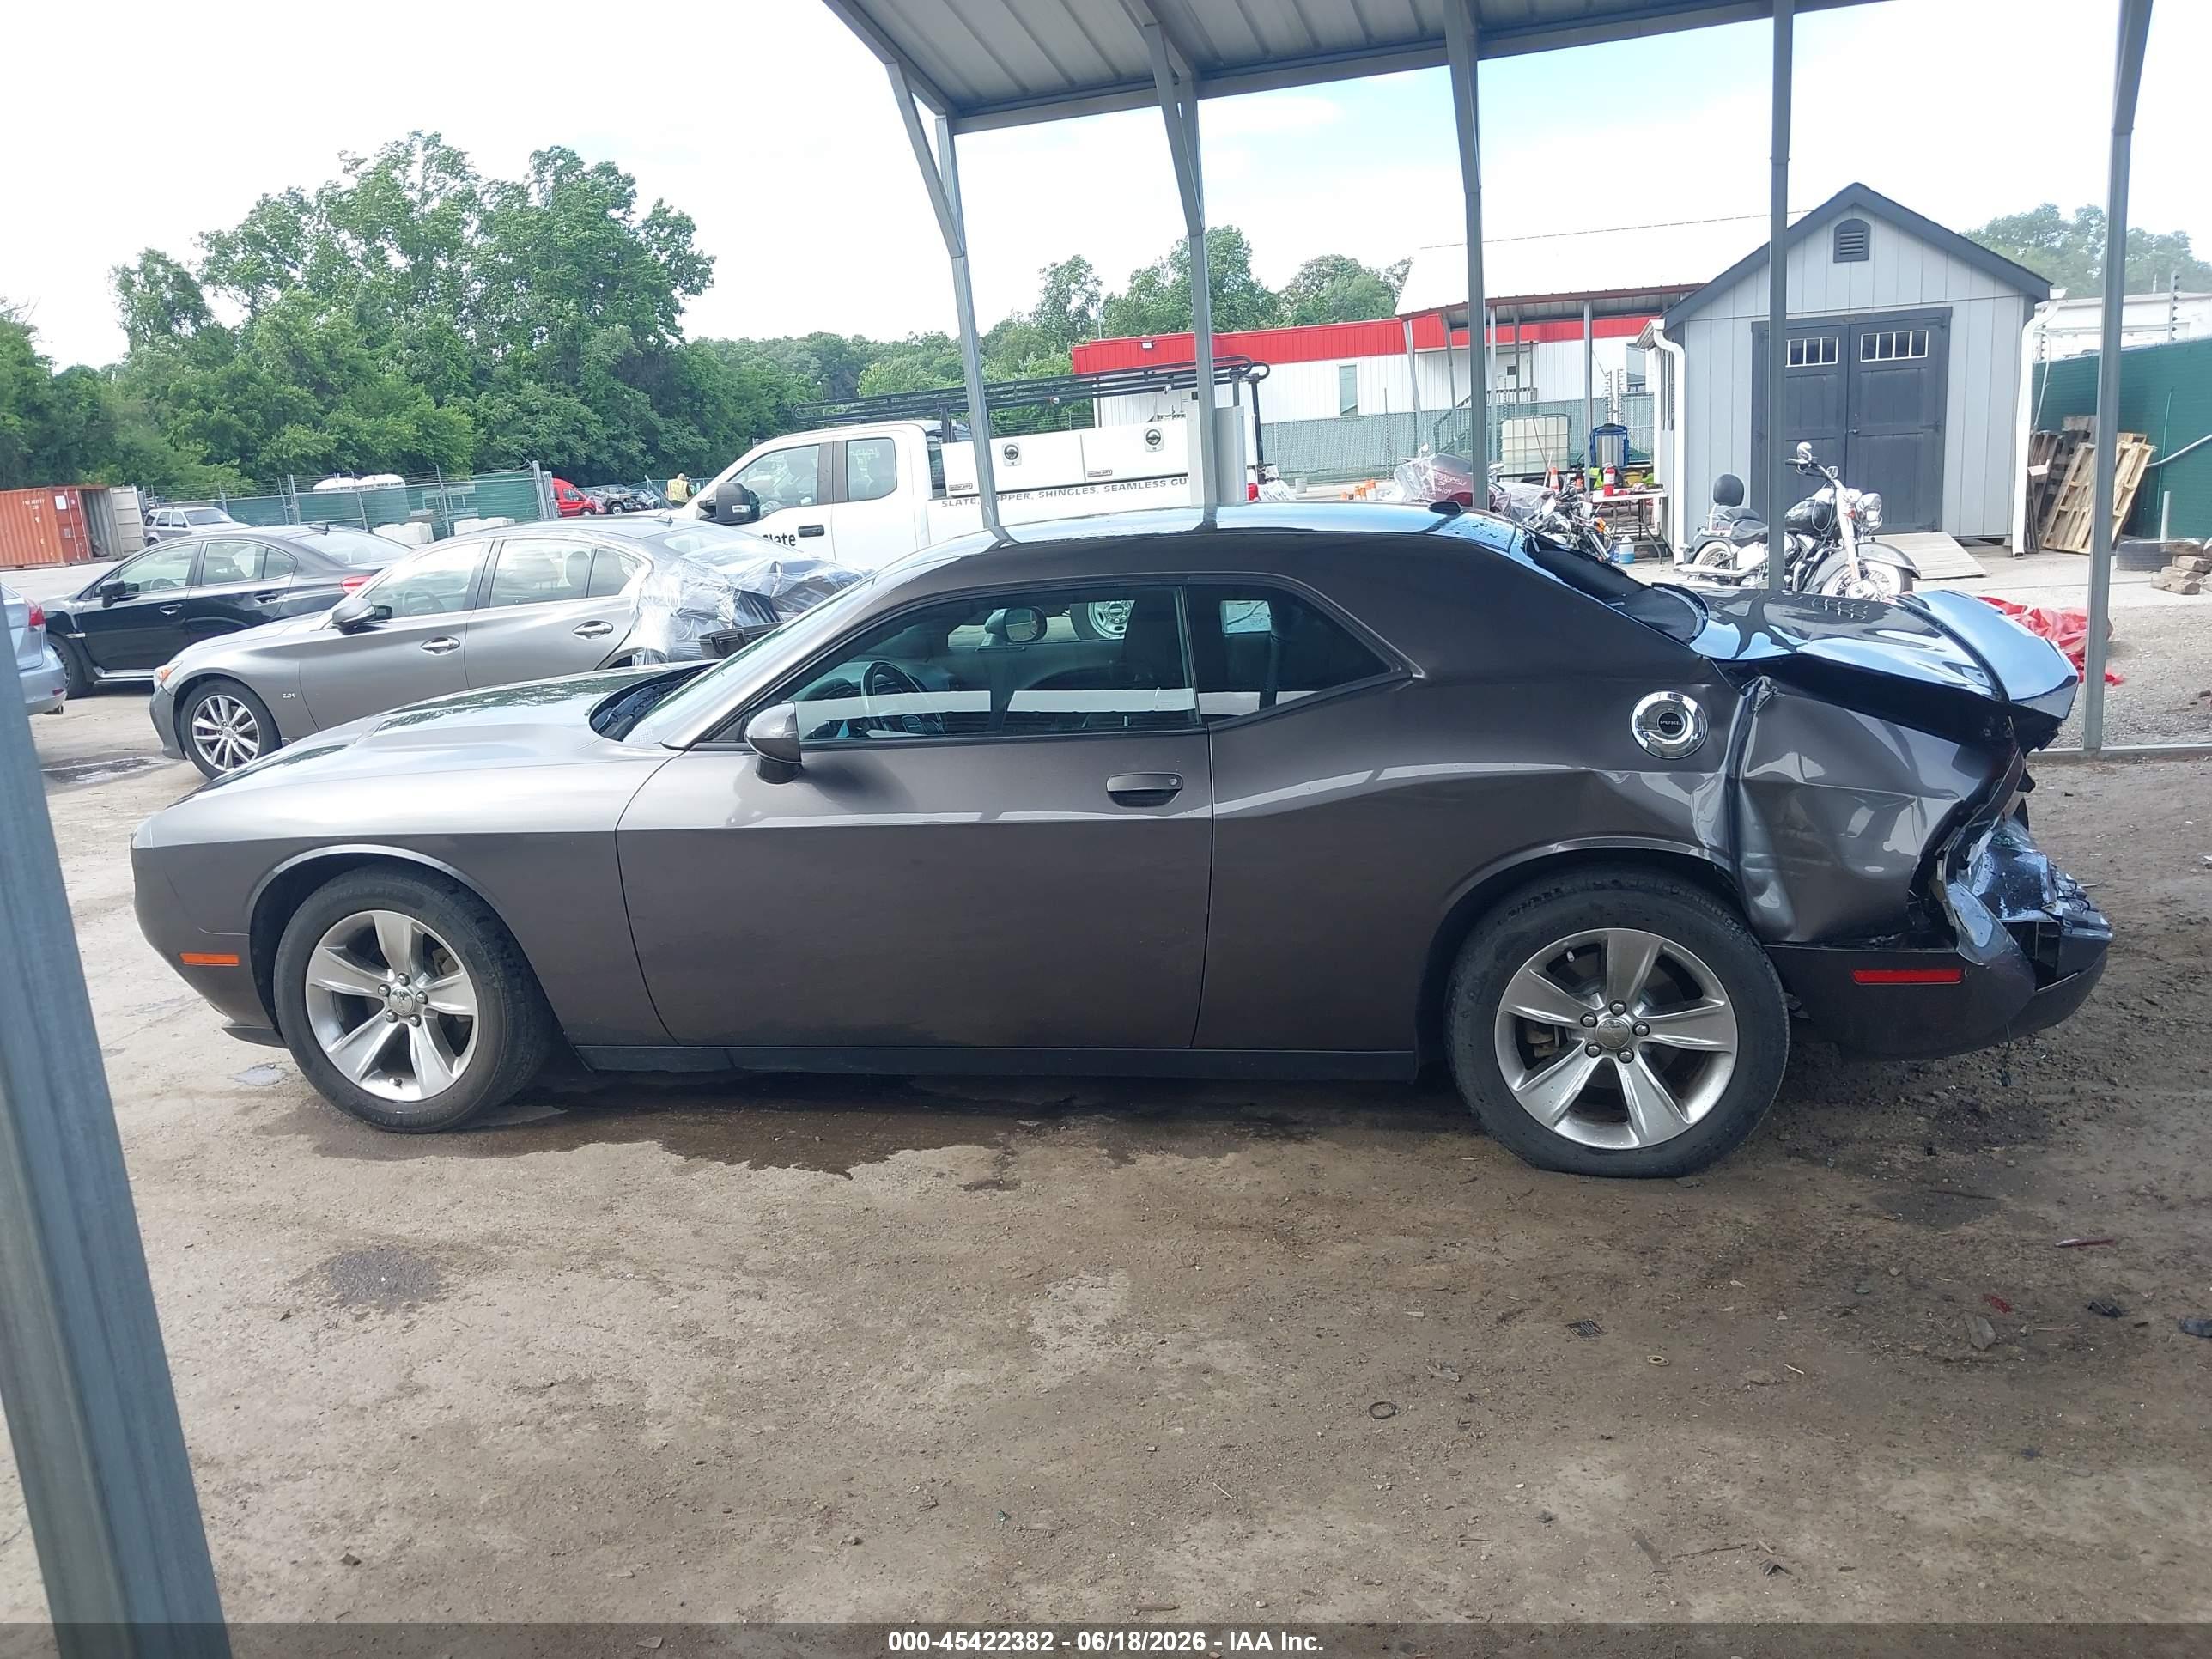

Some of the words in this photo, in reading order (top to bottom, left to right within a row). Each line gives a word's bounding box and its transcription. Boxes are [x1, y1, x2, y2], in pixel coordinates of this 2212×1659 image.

[942, 497, 980, 507] SLATE,
[1104, 481, 1166, 492] SEAMLESS
[1170, 477, 1189, 486] GU
